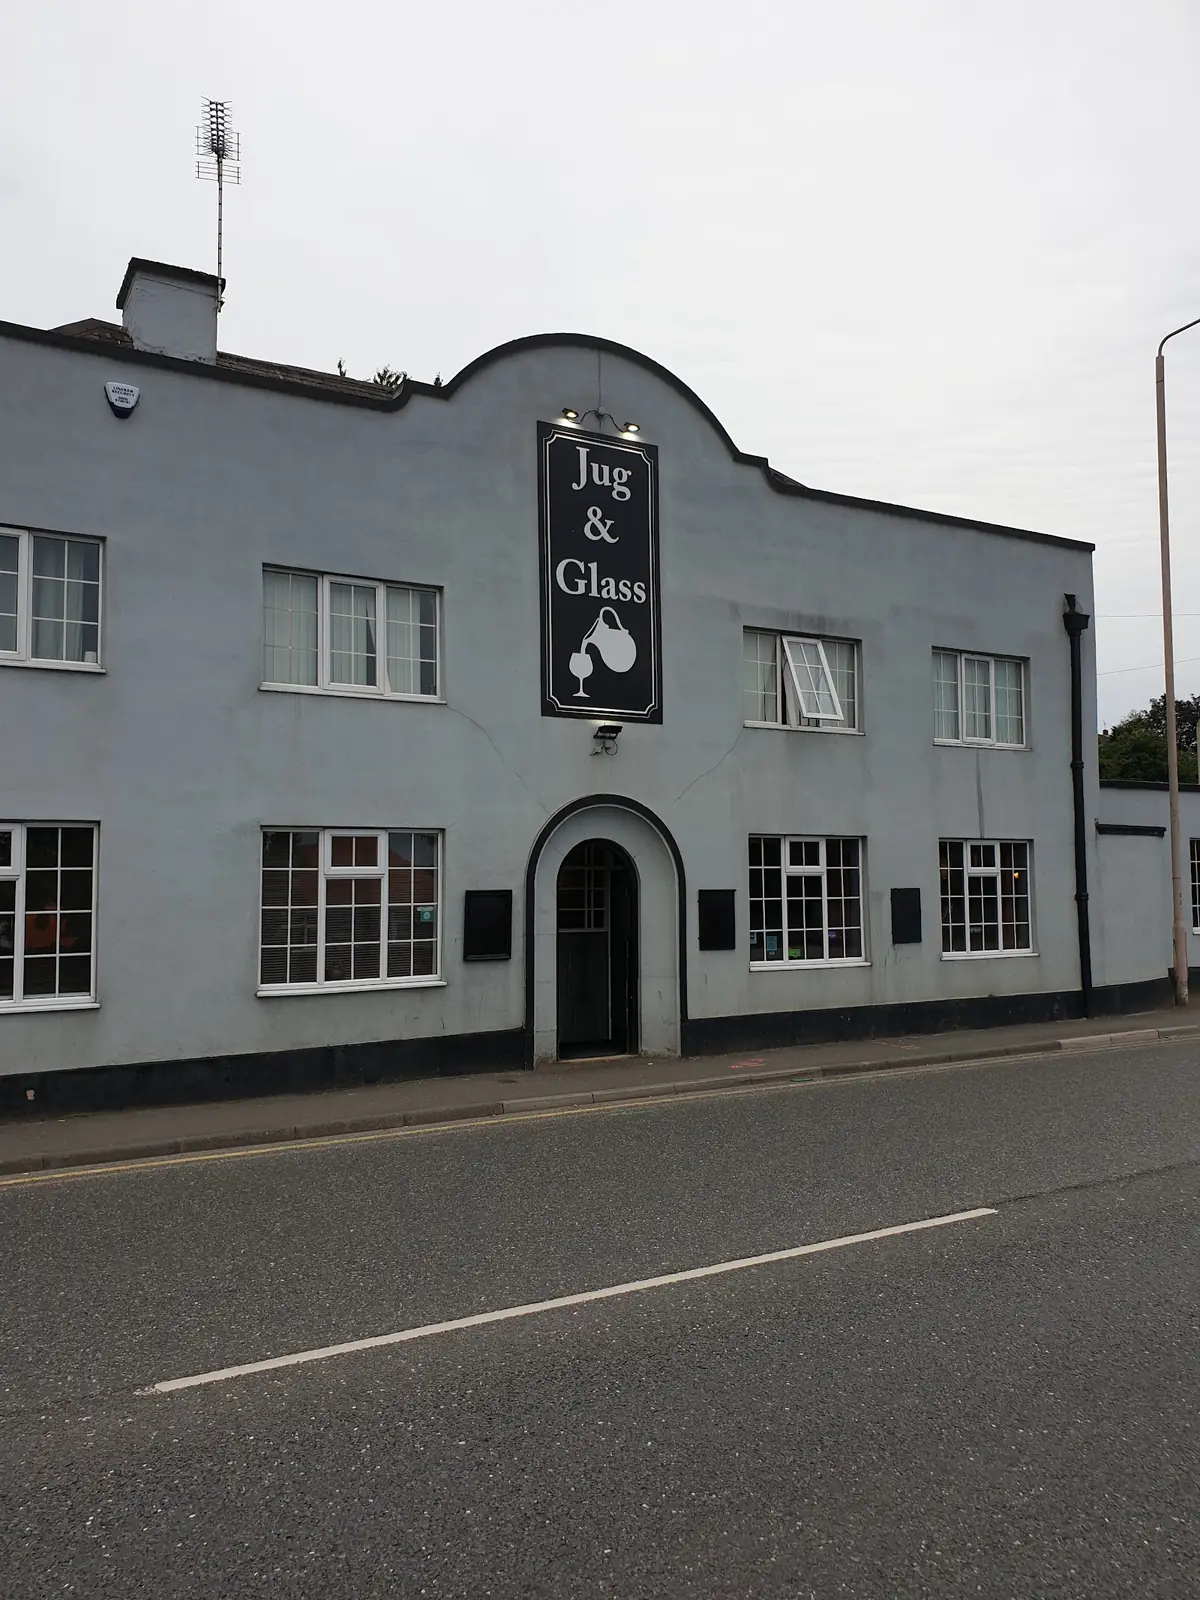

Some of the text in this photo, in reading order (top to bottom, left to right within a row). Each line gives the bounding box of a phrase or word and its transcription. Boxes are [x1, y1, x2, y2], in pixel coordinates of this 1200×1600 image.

[571, 446, 632, 502] Jug
[583, 506, 619, 544] &
[555, 558, 647, 604] Glass
